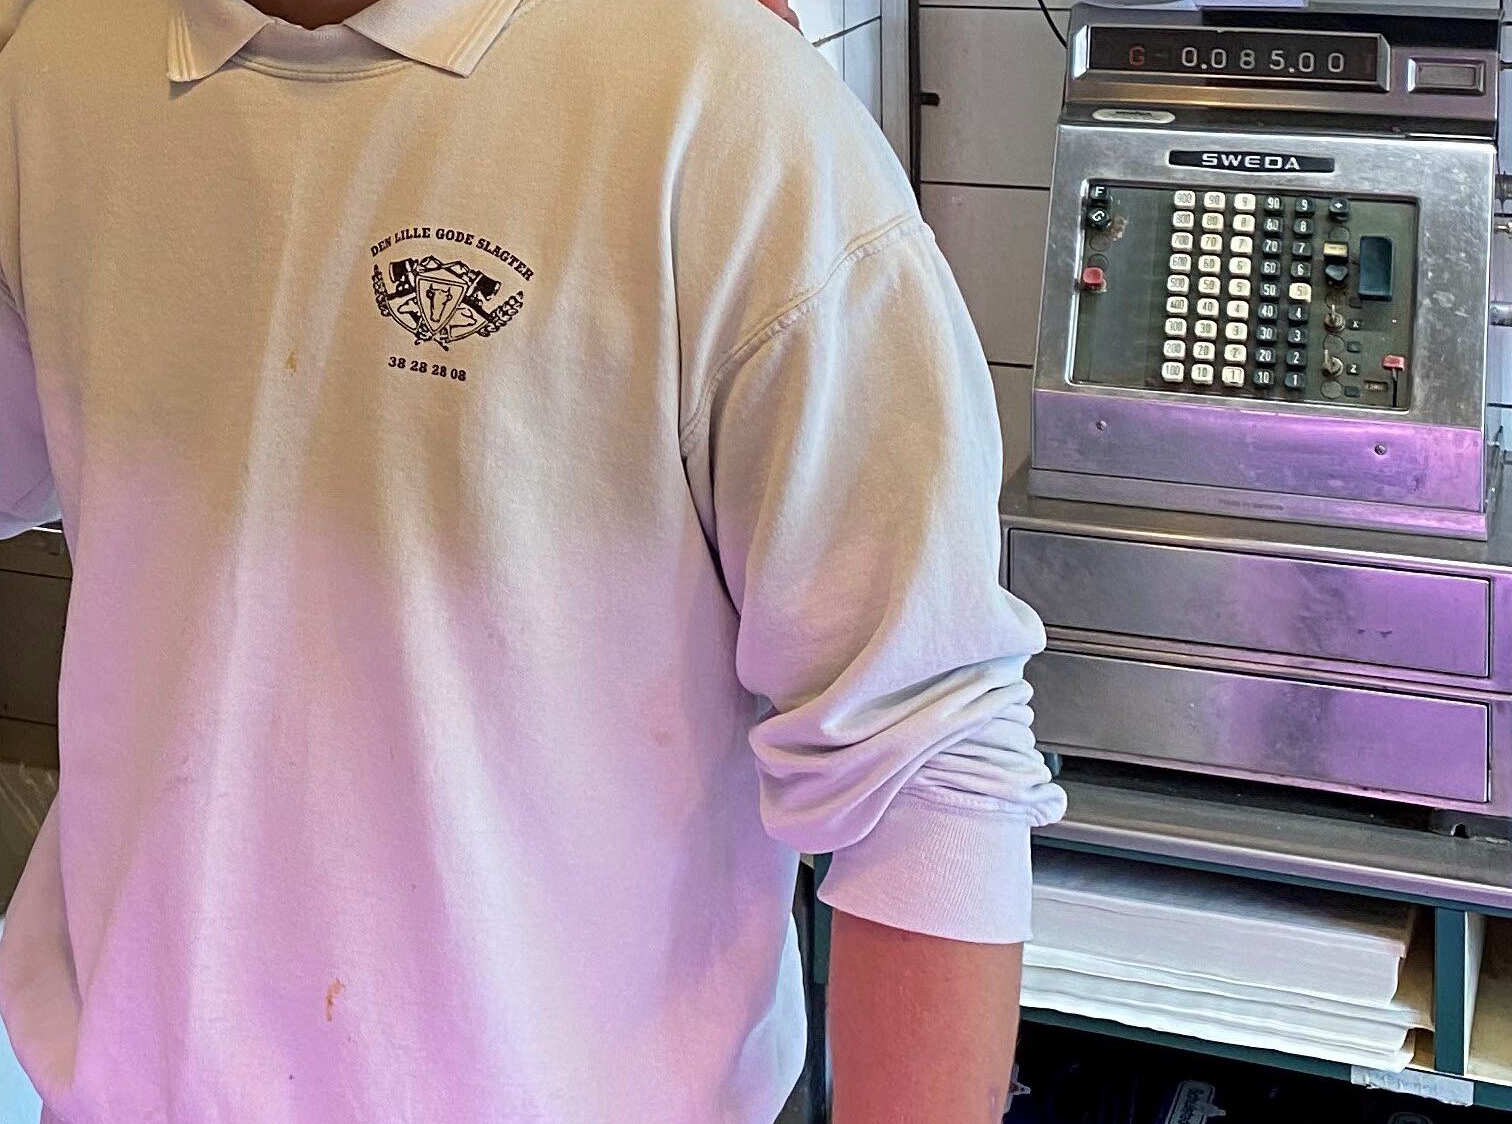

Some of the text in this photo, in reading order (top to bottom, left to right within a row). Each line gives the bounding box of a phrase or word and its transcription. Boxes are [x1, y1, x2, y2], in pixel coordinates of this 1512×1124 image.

[1201, 152, 1302, 171] SWEDA
[1094, 186, 1105, 197] F
[1267, 197, 1280, 209] 90
[1266, 240, 1278, 252] 70
[370, 227, 535, 282] DEN LILLE GODE SLAGTER
[1264, 261, 1277, 274] 60
[1263, 284, 1276, 296] 50
[1261, 305, 1274, 318] 40
[1260, 327, 1273, 340] 30
[1259, 349, 1272, 362] 20
[387, 356, 467, 381] 38 28 28 08
[1197, 367, 1208, 378] 10
[1257, 371, 1270, 383] 10
